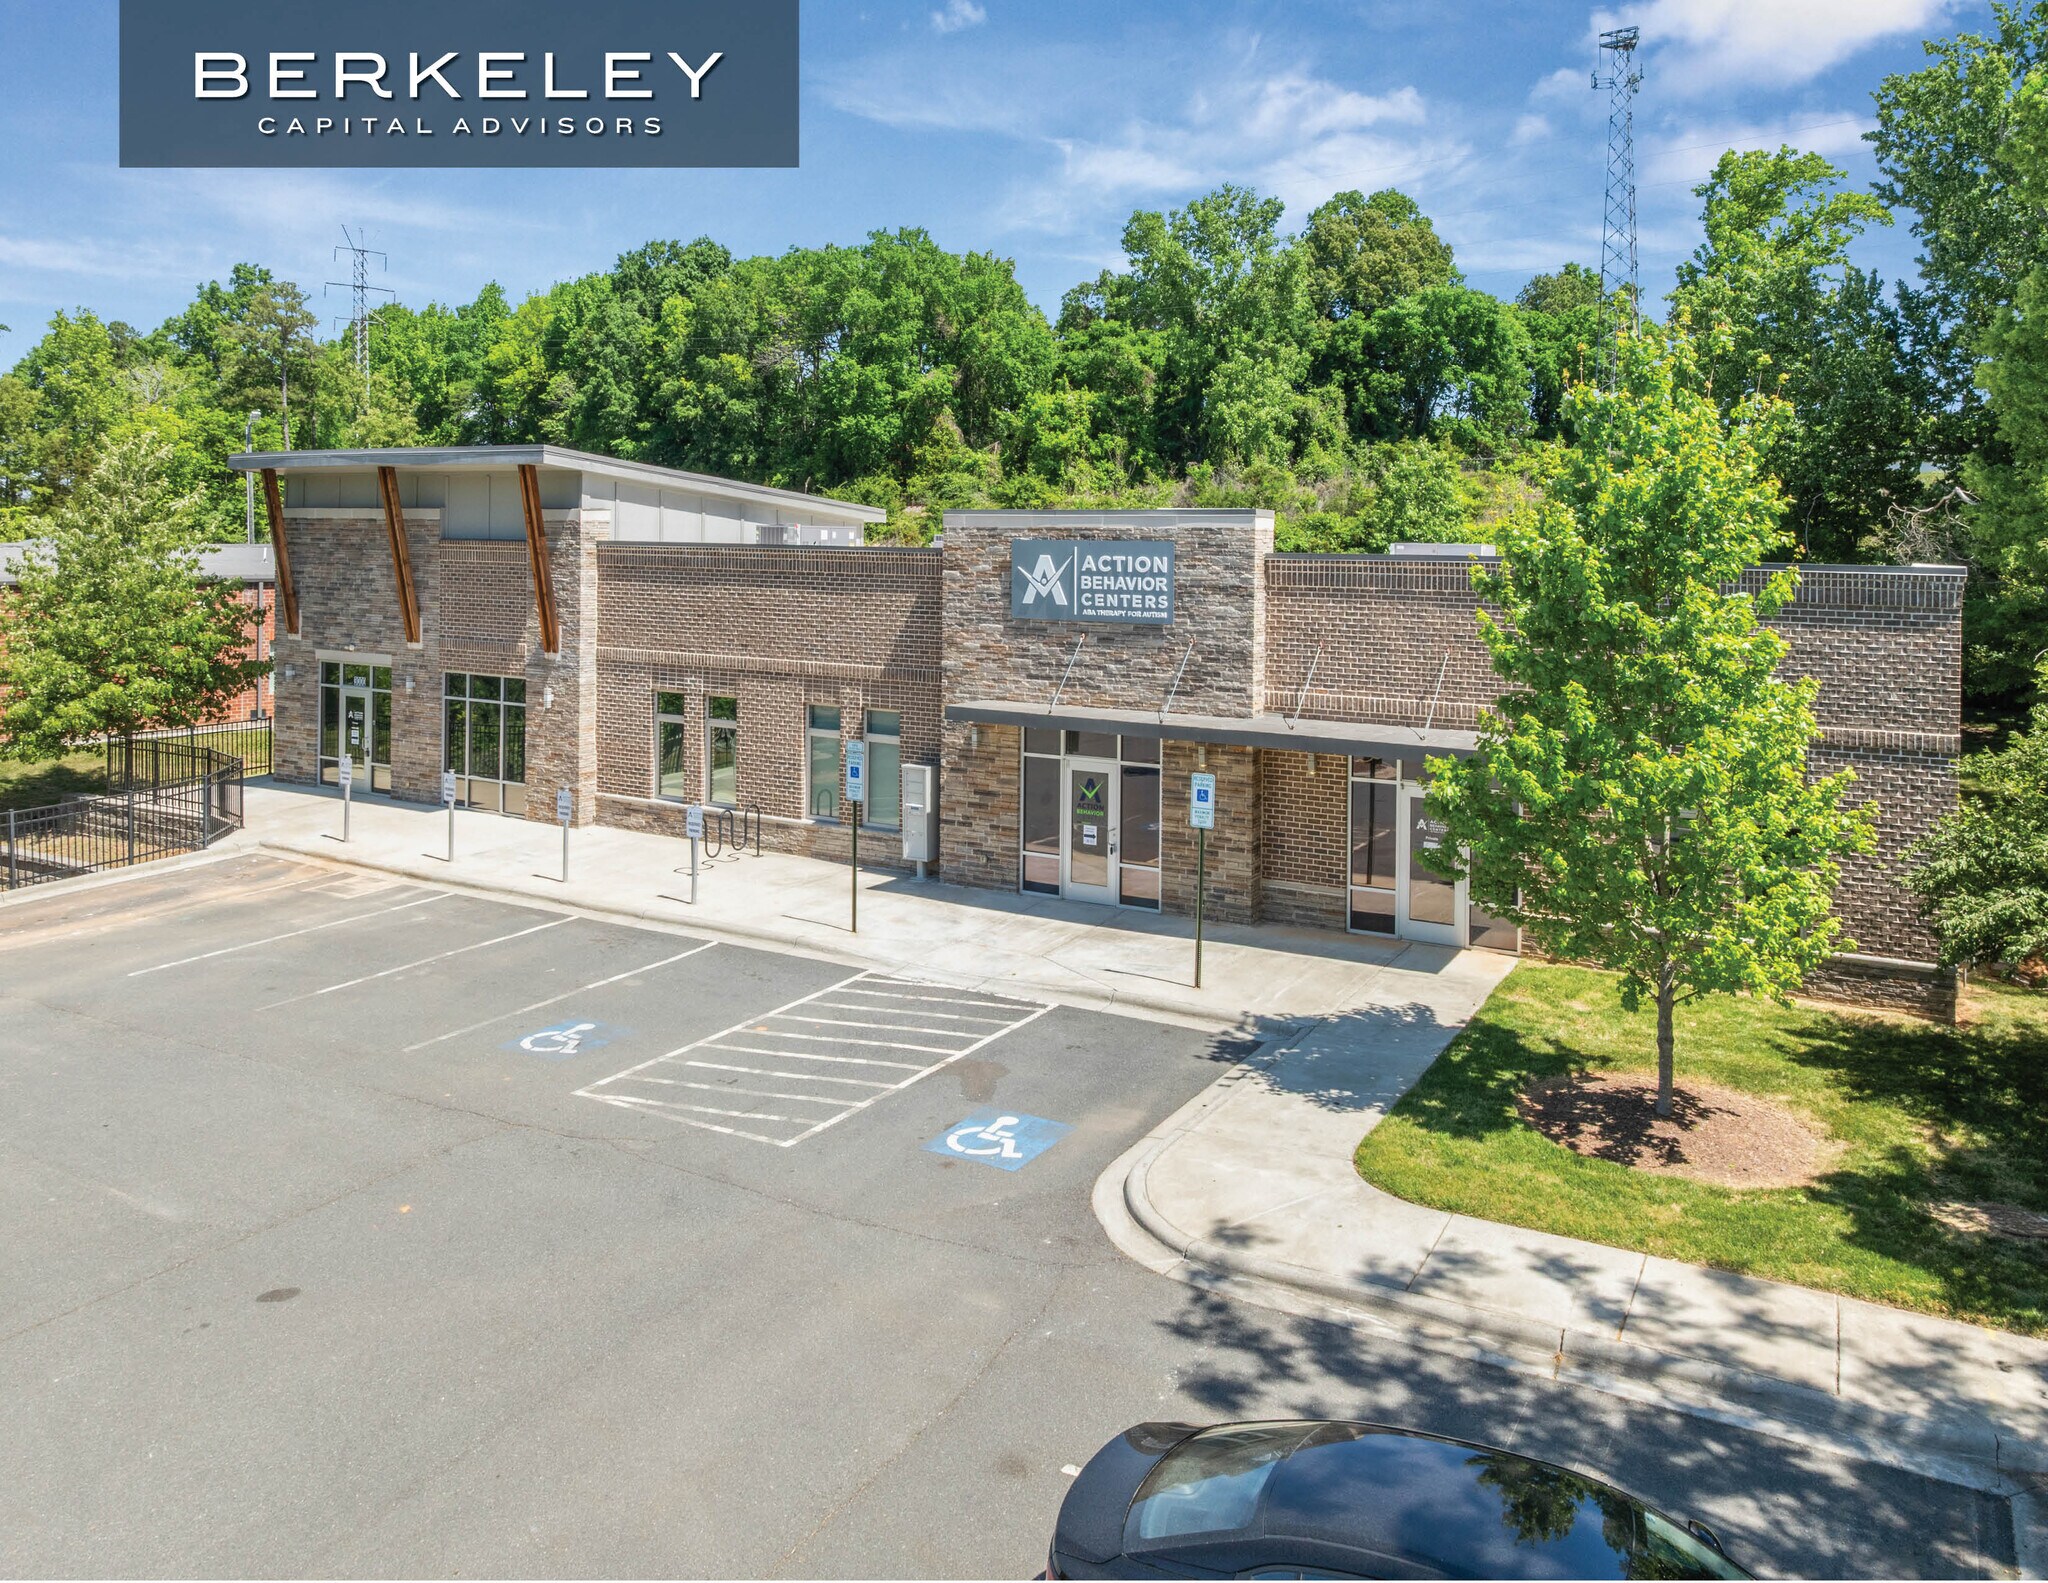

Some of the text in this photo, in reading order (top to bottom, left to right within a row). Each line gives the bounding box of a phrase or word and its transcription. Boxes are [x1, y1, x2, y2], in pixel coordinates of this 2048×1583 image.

[1081, 555, 1168, 573] ACTION
[1081, 575, 1168, 592] BEHAVIOR
[1081, 593, 1168, 609] CENTERS
[1077, 802, 1104, 811] ACTION
[1077, 808, 1104, 816] BEHAVIOR
